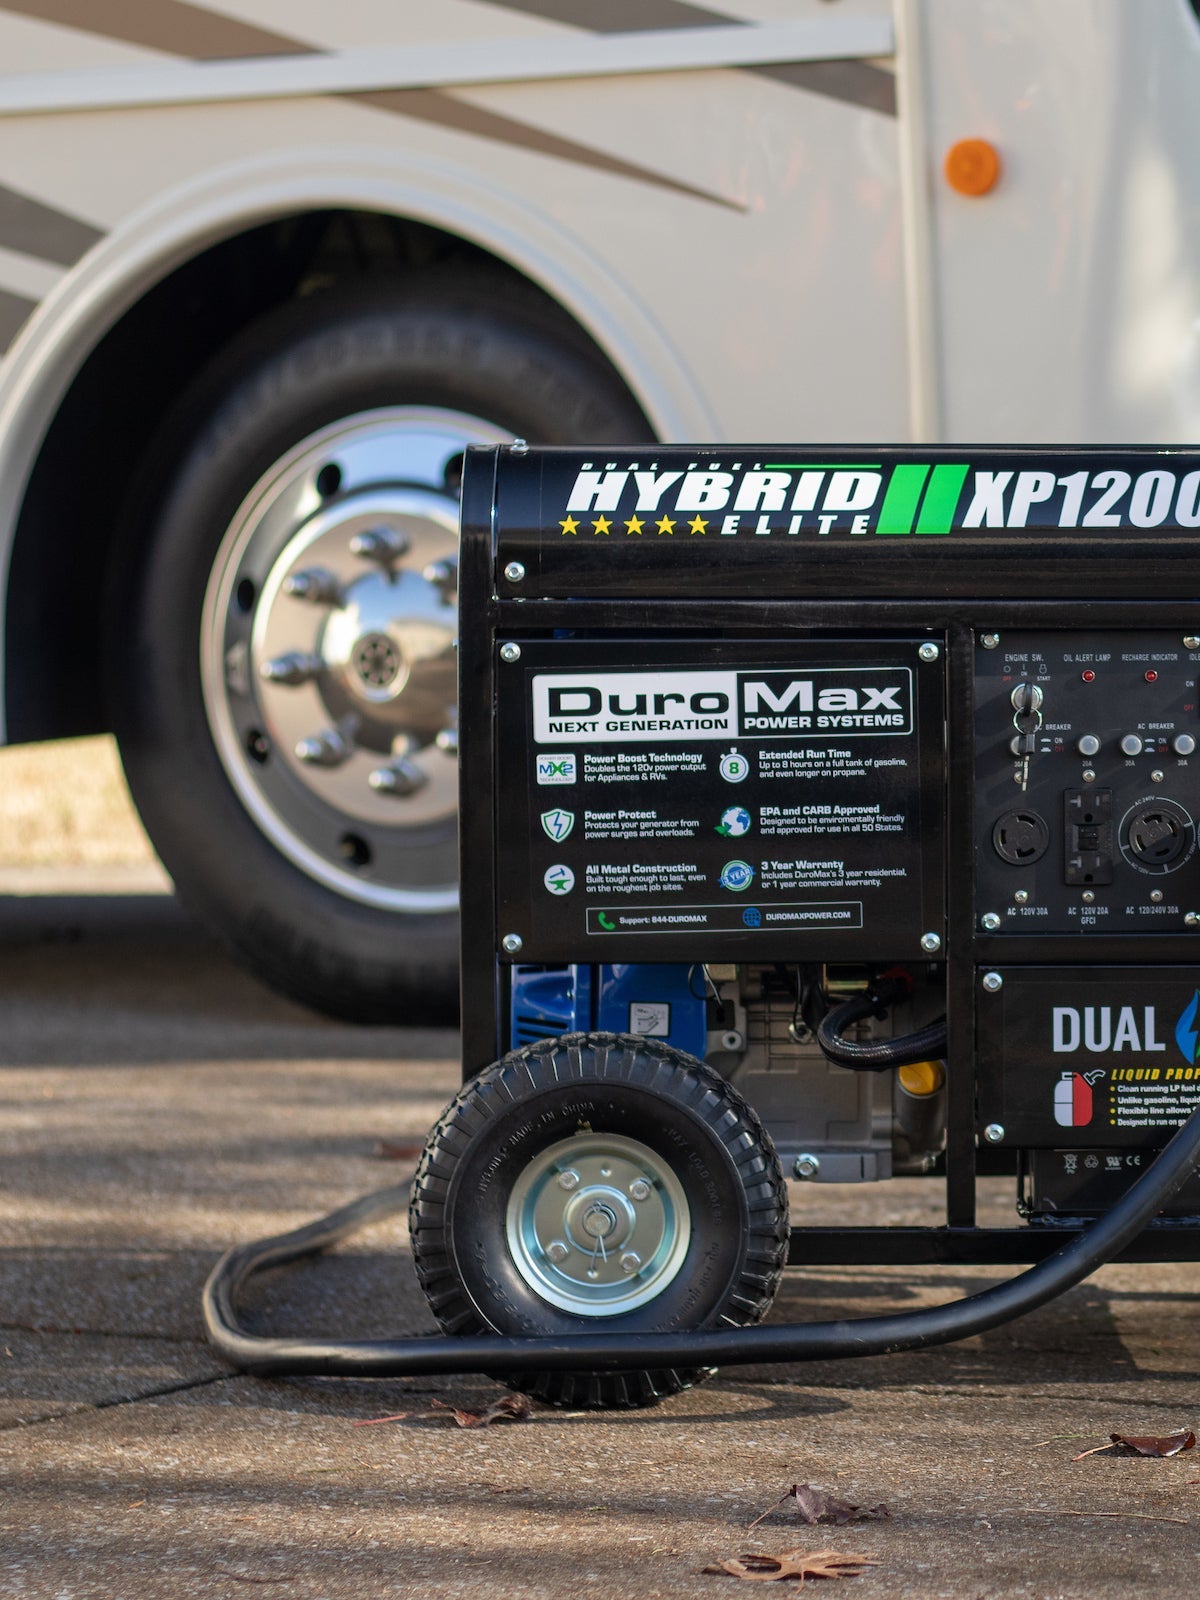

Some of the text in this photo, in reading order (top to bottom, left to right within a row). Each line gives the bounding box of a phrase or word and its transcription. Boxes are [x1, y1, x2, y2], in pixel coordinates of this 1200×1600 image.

[580, 463, 763, 471] DUAL FUEL
[565, 471, 882, 511] HYBRID
[720, 515, 870, 535] ELITE
[1005, 653, 1044, 662] ENGINE SW.
[1063, 653, 1111, 662] OIL ALERT LAMP
[1121, 653, 1178, 661] RECHARGE INDICATOR
[1189, 653, 1200, 661] IDLE
[1185, 680, 1195, 688] ON
[549, 713, 904, 733] NEXT GENERATION POWER SYSTEMS
[1046, 723, 1072, 731] BREAKER
[1137, 722, 1175, 730] AC BREAKER
[584, 752, 702, 764] Power Boost Technology
[759, 748, 852, 760] Extended Run Time
[539, 761, 573, 777] MX2
[584, 762, 707, 773] Doubles the 120v power output
[730, 762, 740, 774] 8
[759, 761, 771, 771] Up
[790, 759, 813, 769] hours
[814, 760, 823, 768] on
[832, 759, 845, 768] full
[846, 758, 863, 767] tank
[584, 771, 669, 783] for Appliances RVs.
[759, 767, 868, 779] and even longer propane.
[585, 809, 658, 821] Power Protect
[760, 804, 881, 817] EPA and CARB Approved
[585, 818, 700, 831] Protects your generator from
[760, 813, 906, 826] Designed friendly
[585, 828, 696, 840] power surges and overloads.
[760, 822, 904, 836] and approved for use 50 States.
[586, 862, 697, 874] All Metal Construction
[770, 859, 845, 871] Year Warranty
[586, 875, 605, 884] Built
[605, 874, 628, 884] tough
[629, 874, 658, 884] enough
[729, 867, 752, 881] YEAR
[761, 871, 793, 881] Includes
[794, 869, 837, 880] DuroMax's
[846, 870, 865, 880] year
[598, 883, 612, 892] the
[613, 882, 648, 893] roughest
[779, 877, 882, 889] year commercial warranty.
[1007, 906, 1049, 916] AC 120V 30A
[1068, 906, 1109, 915] AC 120V 20A
[1126, 905, 1179, 914] AC 120/240V 30A
[651, 914, 708, 924] 844-DUROMAX
[765, 911, 851, 921] DUROMAXPOWER.COM
[1081, 916, 1096, 925] GFCI
[1052, 1005, 1165, 1052] DUAL
[1111, 1068, 1161, 1082] LIQUID
[1117, 1085, 1140, 1093] Clean
[1140, 1084, 1169, 1094] running
[1169, 1084, 1181, 1092] LP
[1181, 1084, 1196, 1092] fuel
[1117, 1096, 1143, 1104] Unlike
[1143, 1096, 1180, 1106] gasoline,
[1117, 1106, 1149, 1115] Flexible
[1150, 1106, 1165, 1115] line
[1165, 1106, 1192, 1114] allows
[1117, 1118, 1148, 1127] Designed
